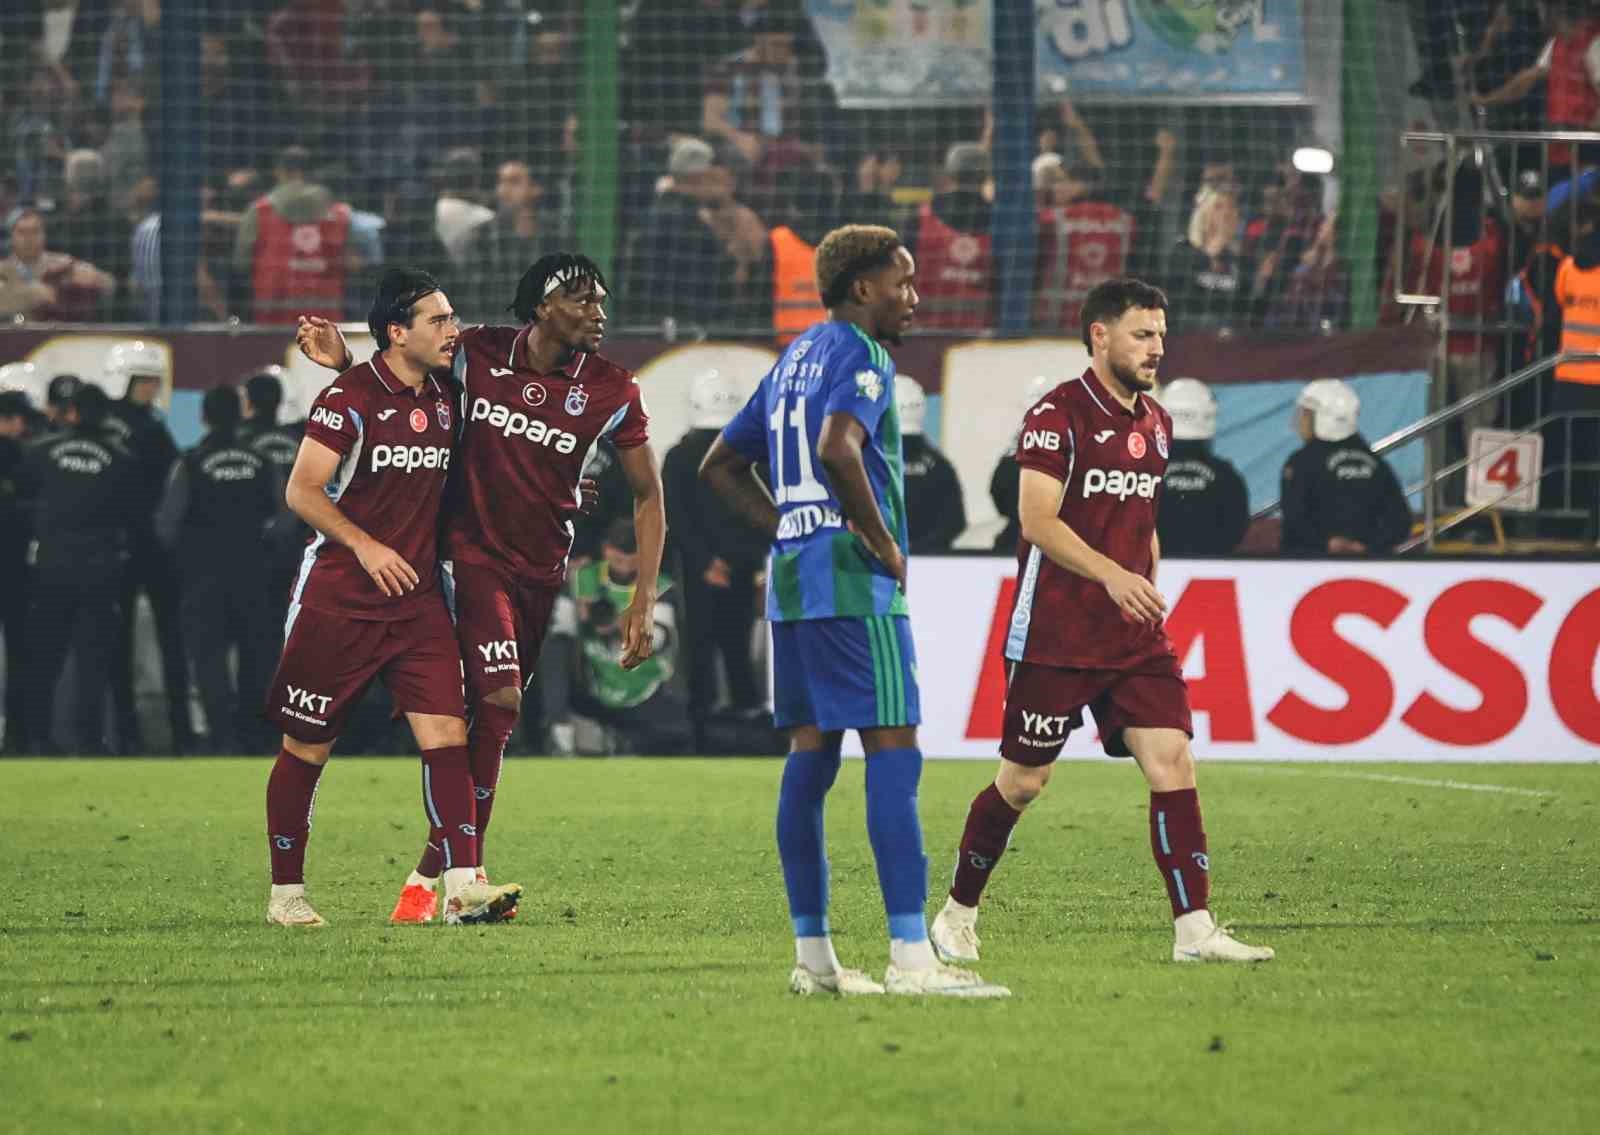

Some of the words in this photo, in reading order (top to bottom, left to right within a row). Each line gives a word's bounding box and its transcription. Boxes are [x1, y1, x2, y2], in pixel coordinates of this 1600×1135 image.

[311, 406, 344, 431] QNB
[470, 397, 578, 455] papara
[770, 396, 830, 505] 11
[1023, 430, 1061, 451] QNB
[1083, 468, 1162, 501] papar
[1486, 447, 1521, 492] 4
[478, 640, 518, 662] YKT
[287, 684, 333, 714] YKT
[1021, 709, 1069, 735] YKT
